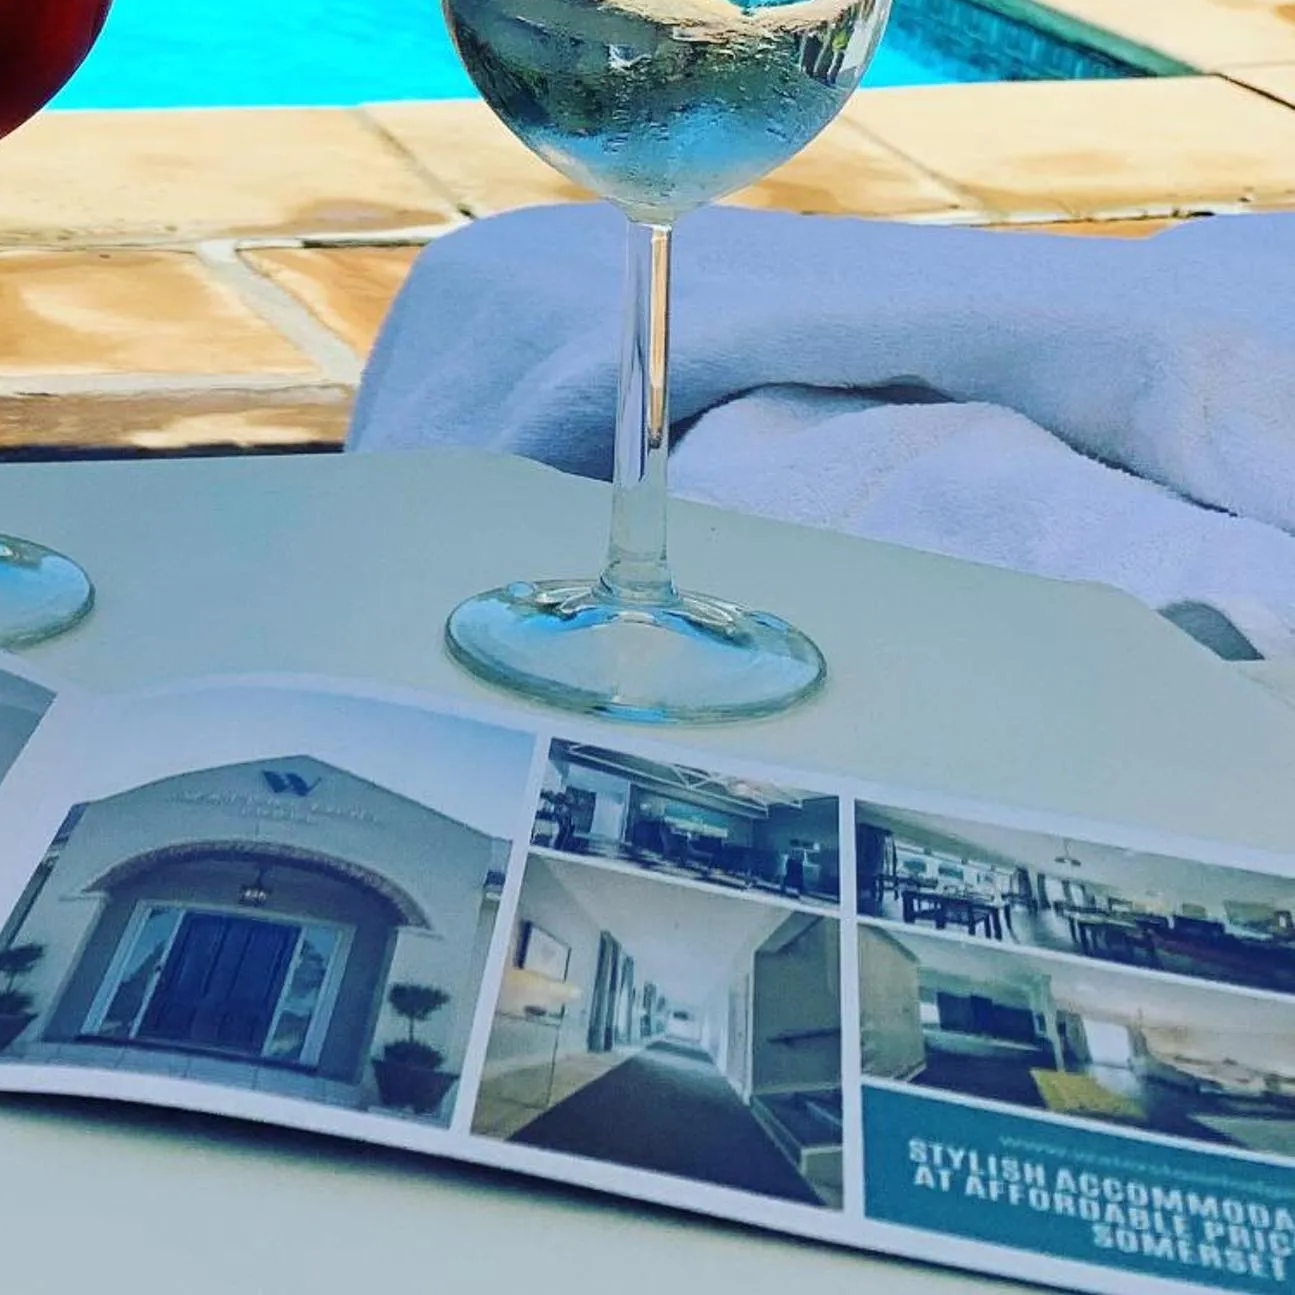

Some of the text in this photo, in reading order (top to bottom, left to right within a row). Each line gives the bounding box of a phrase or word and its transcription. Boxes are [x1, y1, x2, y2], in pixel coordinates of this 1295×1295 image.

[908, 1138, 1046, 1188] STYLISH
[914, 1166, 1295, 1257] AT AFFORDABLE PRIC
[1093, 1224, 1287, 1282] SOMERSET
